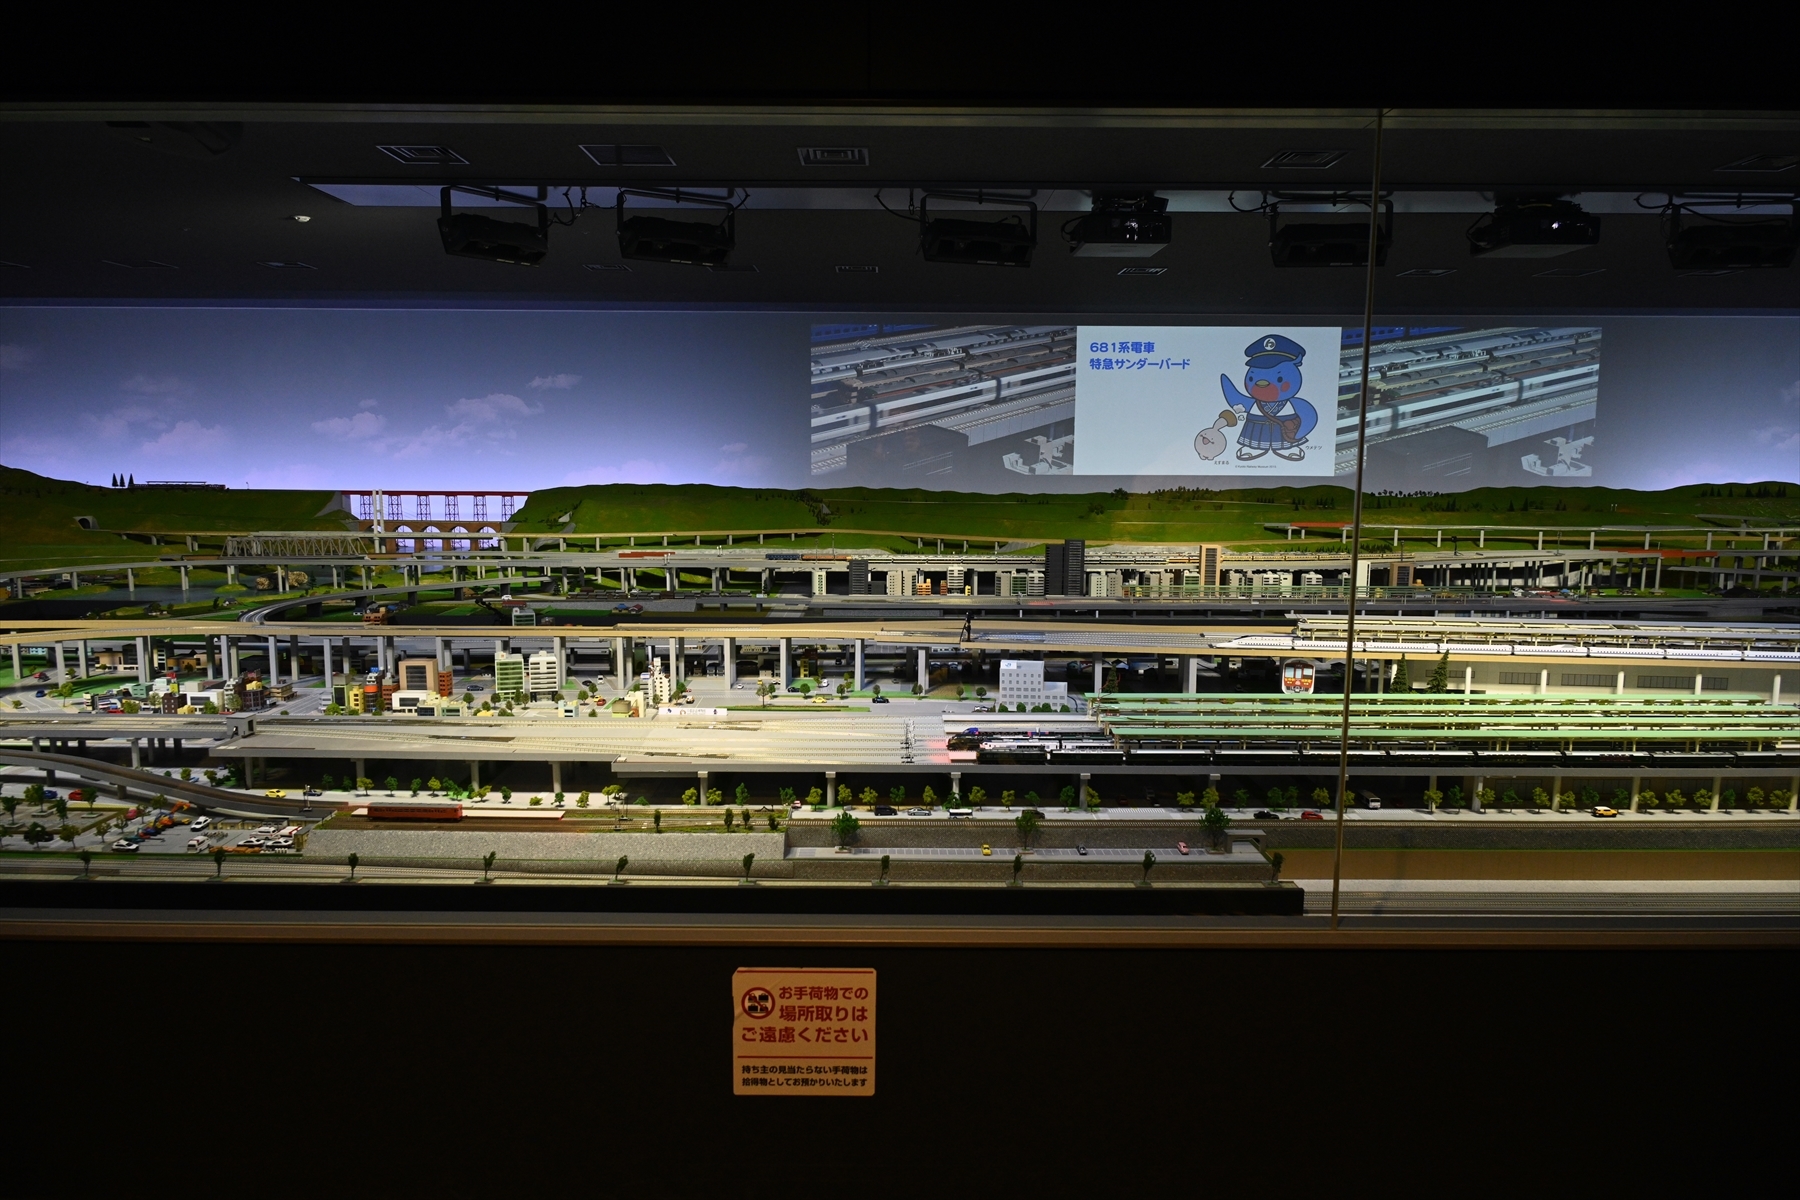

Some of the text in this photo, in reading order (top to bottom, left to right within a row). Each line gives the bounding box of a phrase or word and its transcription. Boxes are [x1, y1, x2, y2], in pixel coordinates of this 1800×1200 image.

[1089, 341, 1155, 354] 681系電車
[1089, 357, 1191, 370] 特急サンダーバード
[778, 986, 869, 1001] お手荷物での
[778, 1005, 868, 1022] 場所取りは
[741, 1026, 869, 1043] ご遠慮ください
[741, 1065, 868, 1075] 持ち主の見当たらない手荷物は
[741, 1077, 868, 1087] 拾得物としてお預かりいたします
